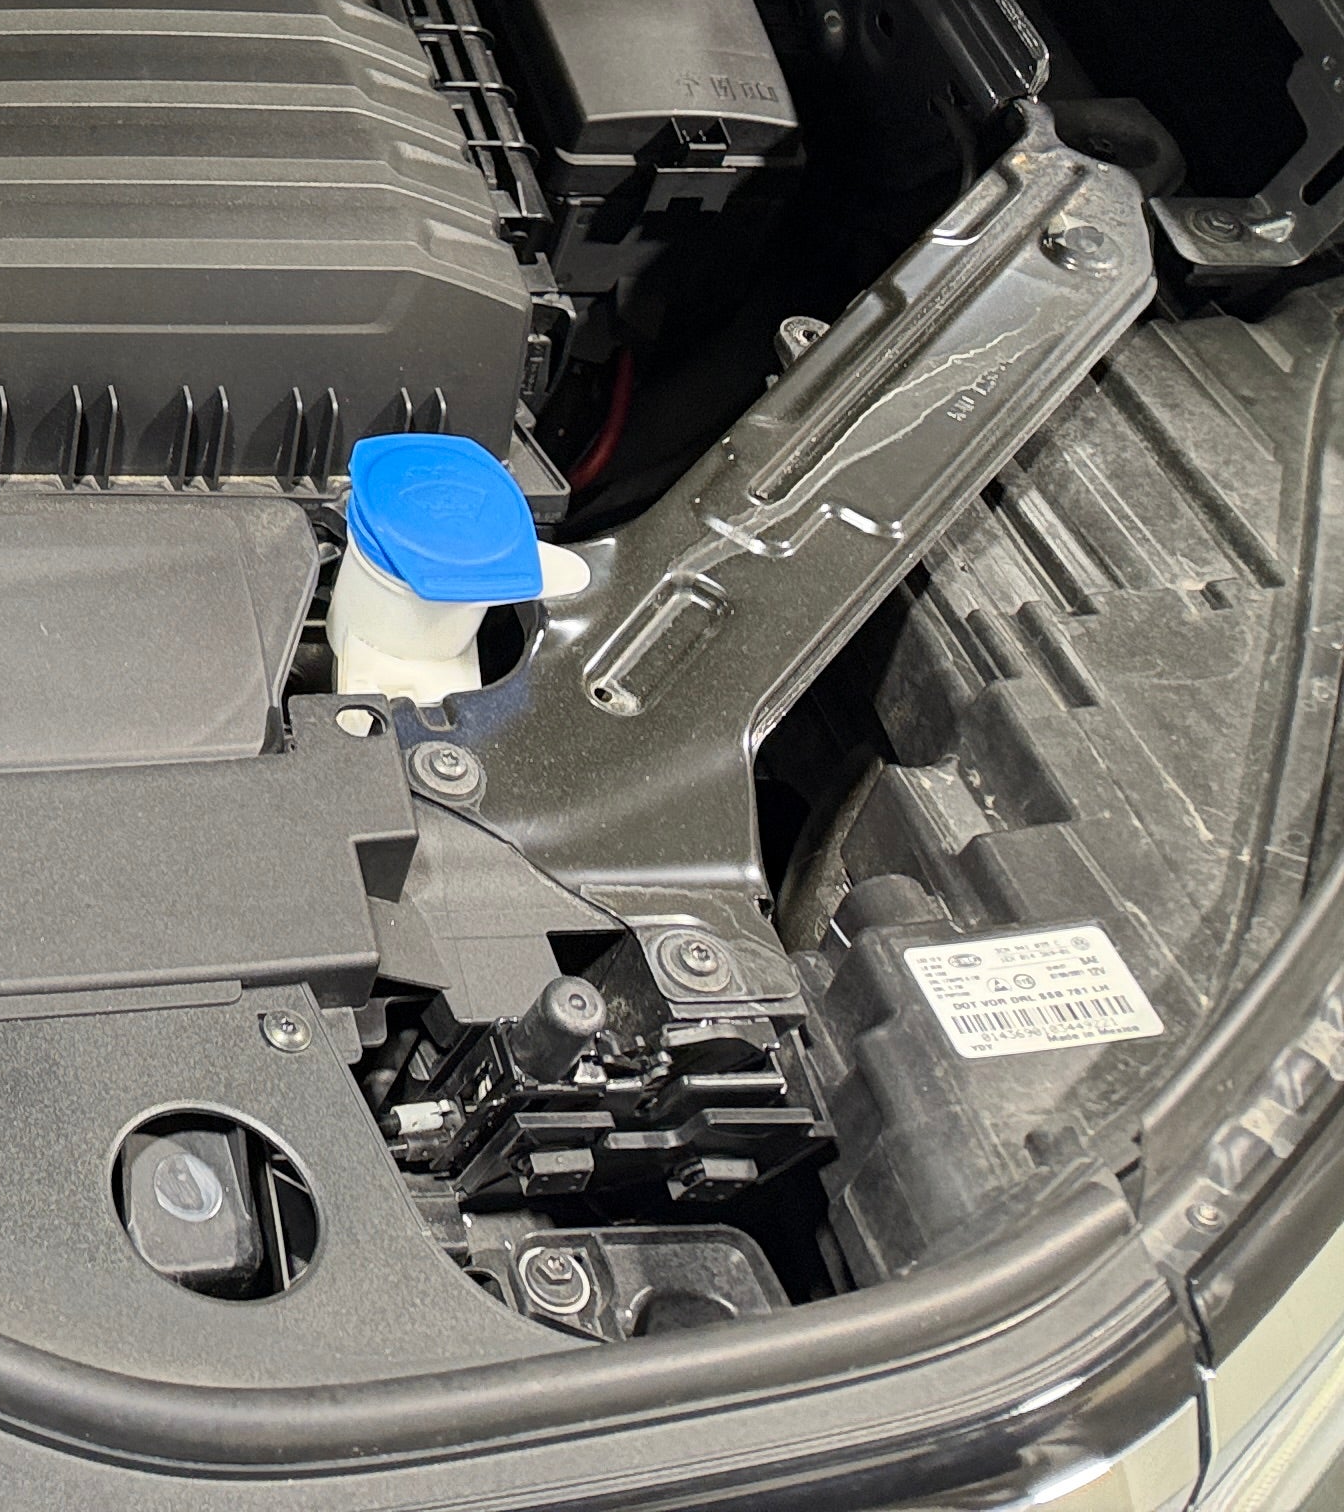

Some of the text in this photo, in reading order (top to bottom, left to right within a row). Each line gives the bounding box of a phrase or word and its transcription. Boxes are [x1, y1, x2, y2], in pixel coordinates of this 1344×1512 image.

[953, 1001, 977, 1010] DOT
[1047, 1025, 1140, 1043] Made in Mexico
